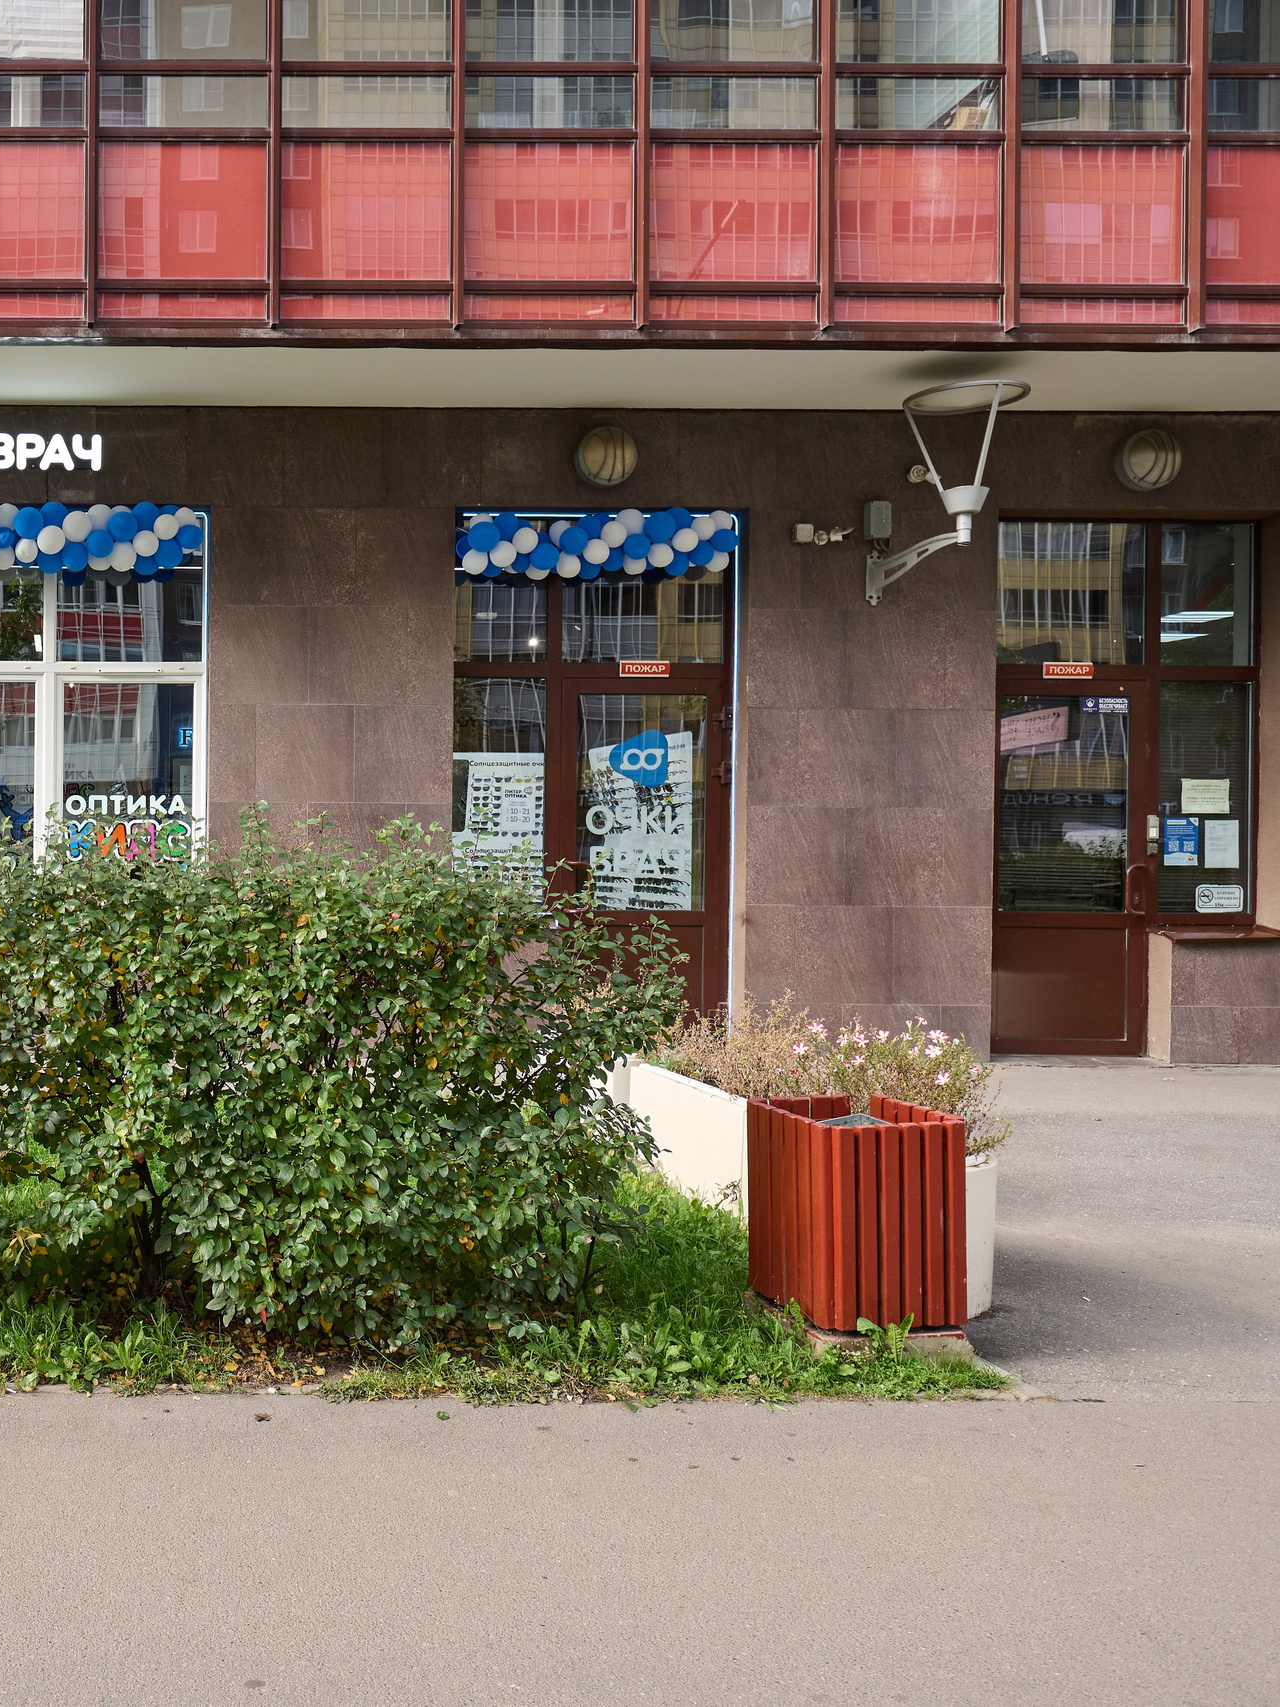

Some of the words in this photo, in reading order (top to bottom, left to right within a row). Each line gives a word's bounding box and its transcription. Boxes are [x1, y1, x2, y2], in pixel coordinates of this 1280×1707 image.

[624, 664, 666, 673] ПОЖАР
[1049, 666, 1090, 675] ПОЖАР
[469, 760, 531, 768] Солнцезащитные
[65, 794, 188, 816] ОПТИКА
[585, 805, 691, 835] ОЧКИ
